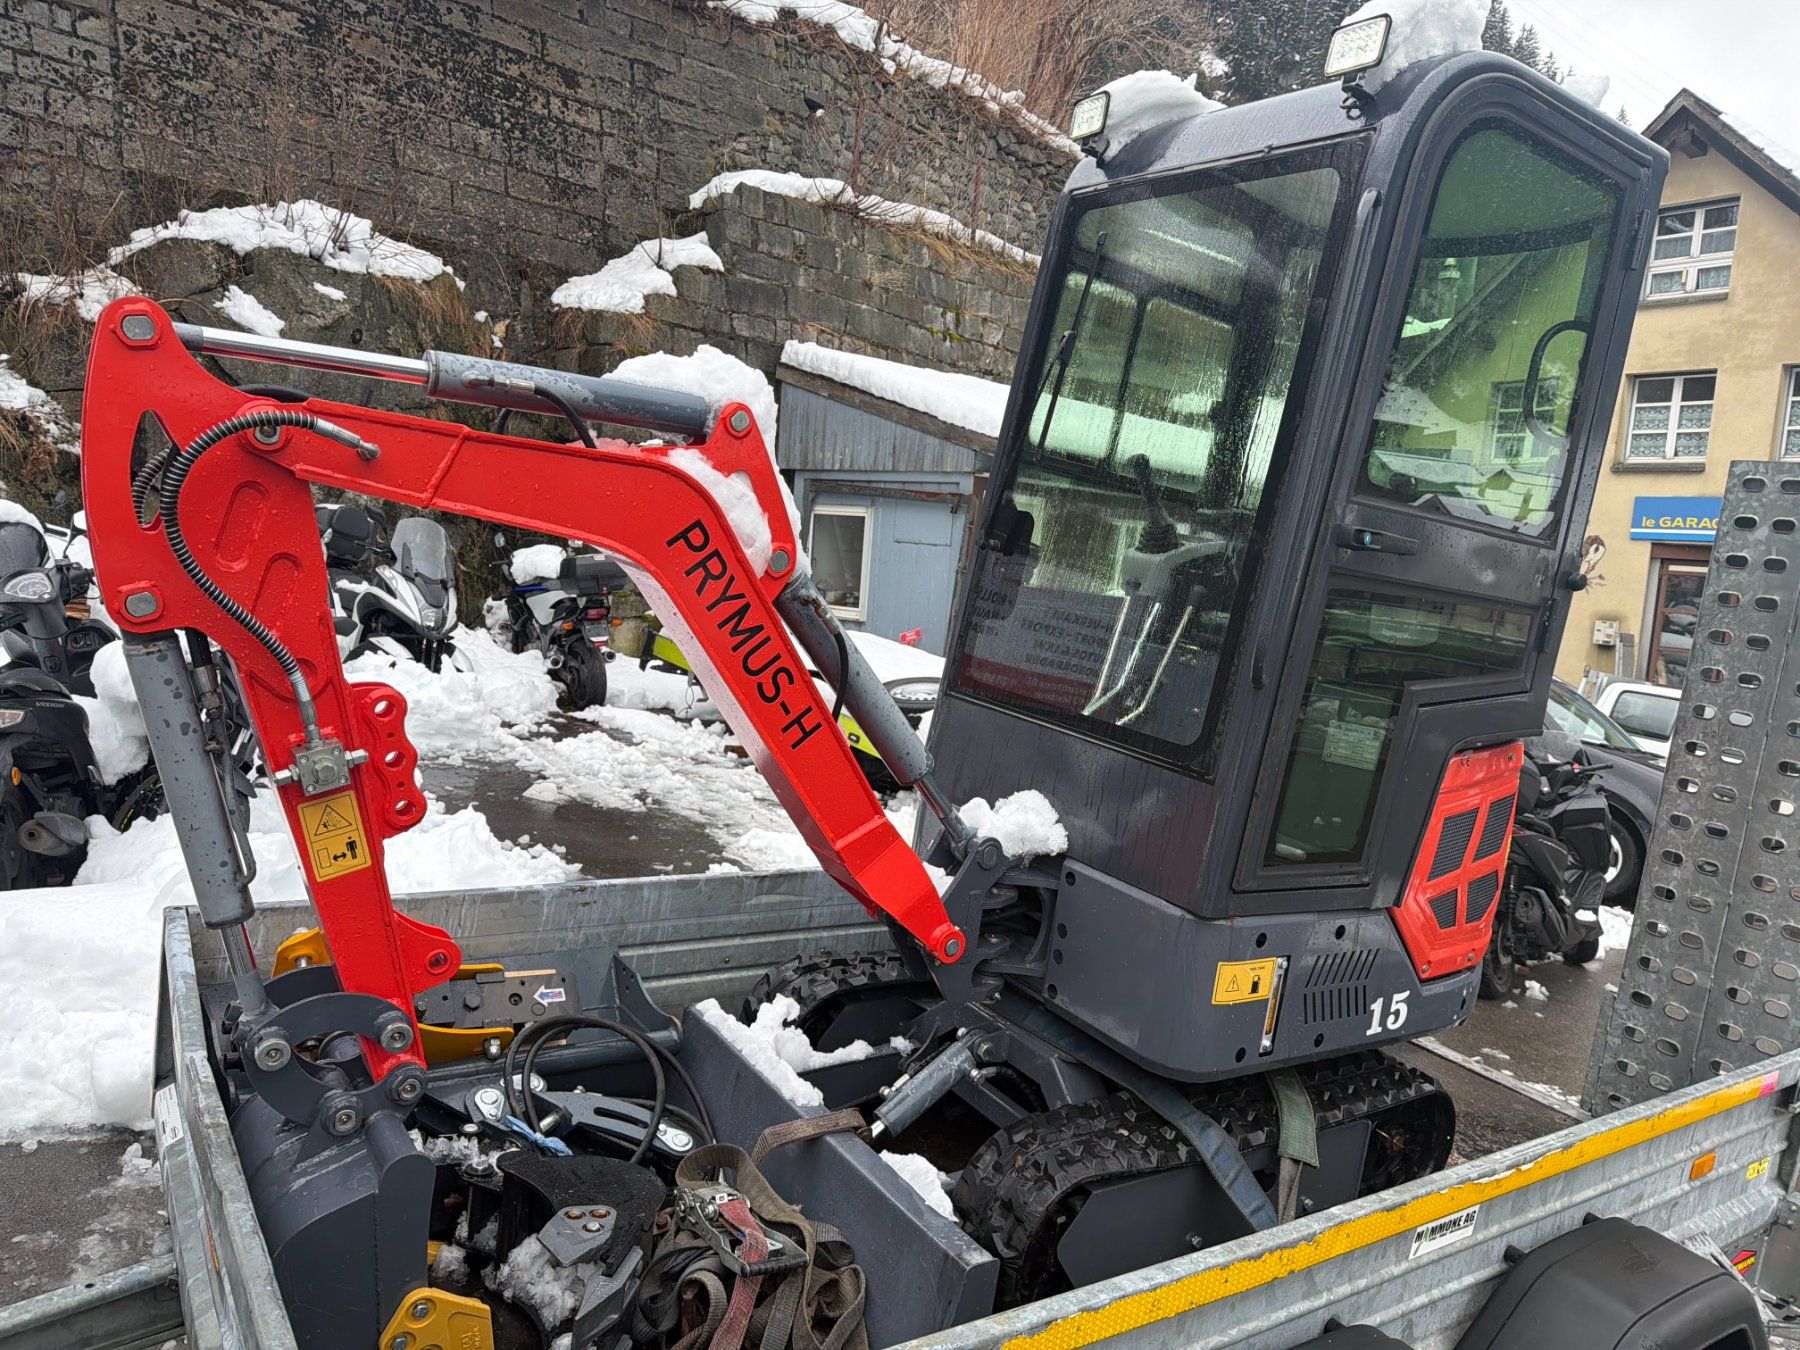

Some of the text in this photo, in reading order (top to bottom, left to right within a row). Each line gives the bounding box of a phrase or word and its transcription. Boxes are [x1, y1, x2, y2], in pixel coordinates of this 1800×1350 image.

[1641, 516, 1655, 527] le
[666, 518, 822, 750] PRYMUS-H
[1366, 990, 1410, 1036] 15
[1463, 1210, 1476, 1224] AG
